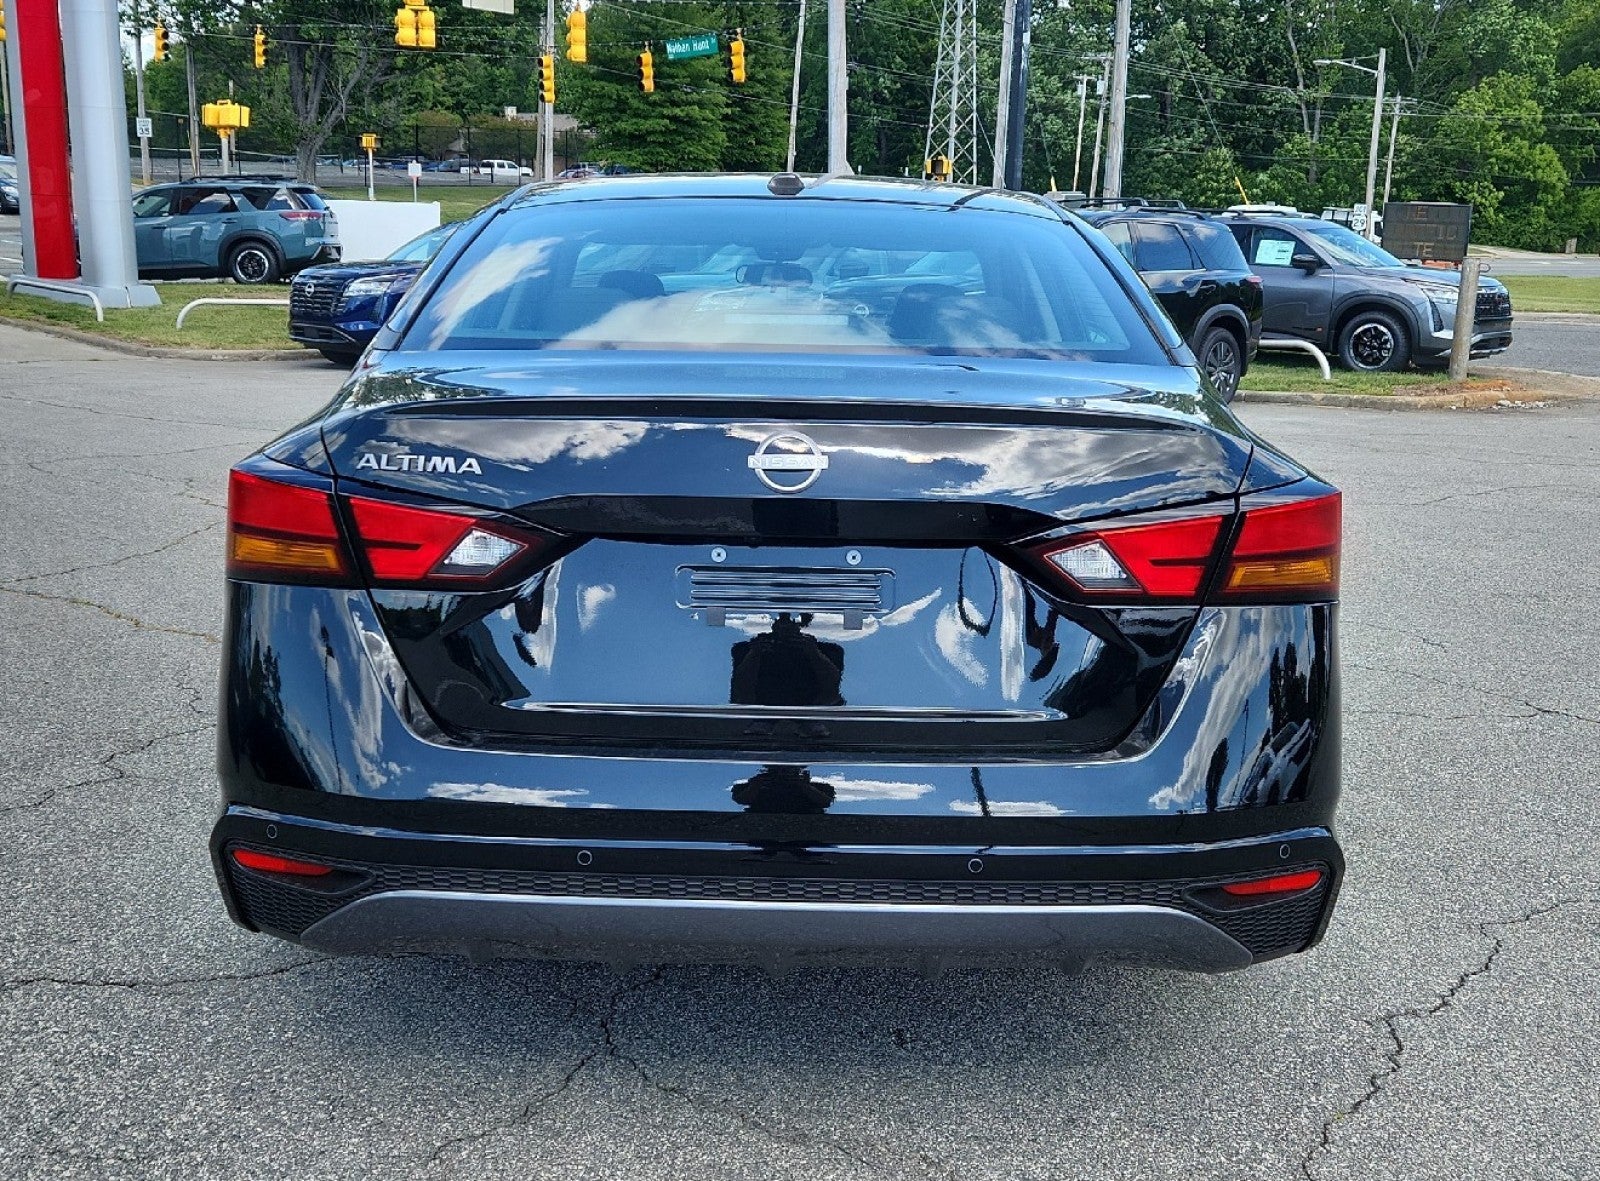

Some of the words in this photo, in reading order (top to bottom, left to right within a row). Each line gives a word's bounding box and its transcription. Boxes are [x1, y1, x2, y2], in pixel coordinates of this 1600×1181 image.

[1353, 218, 1366, 228] 29
[356, 453, 482, 475] ALTIMA
[749, 456, 828, 468] NISSAN
